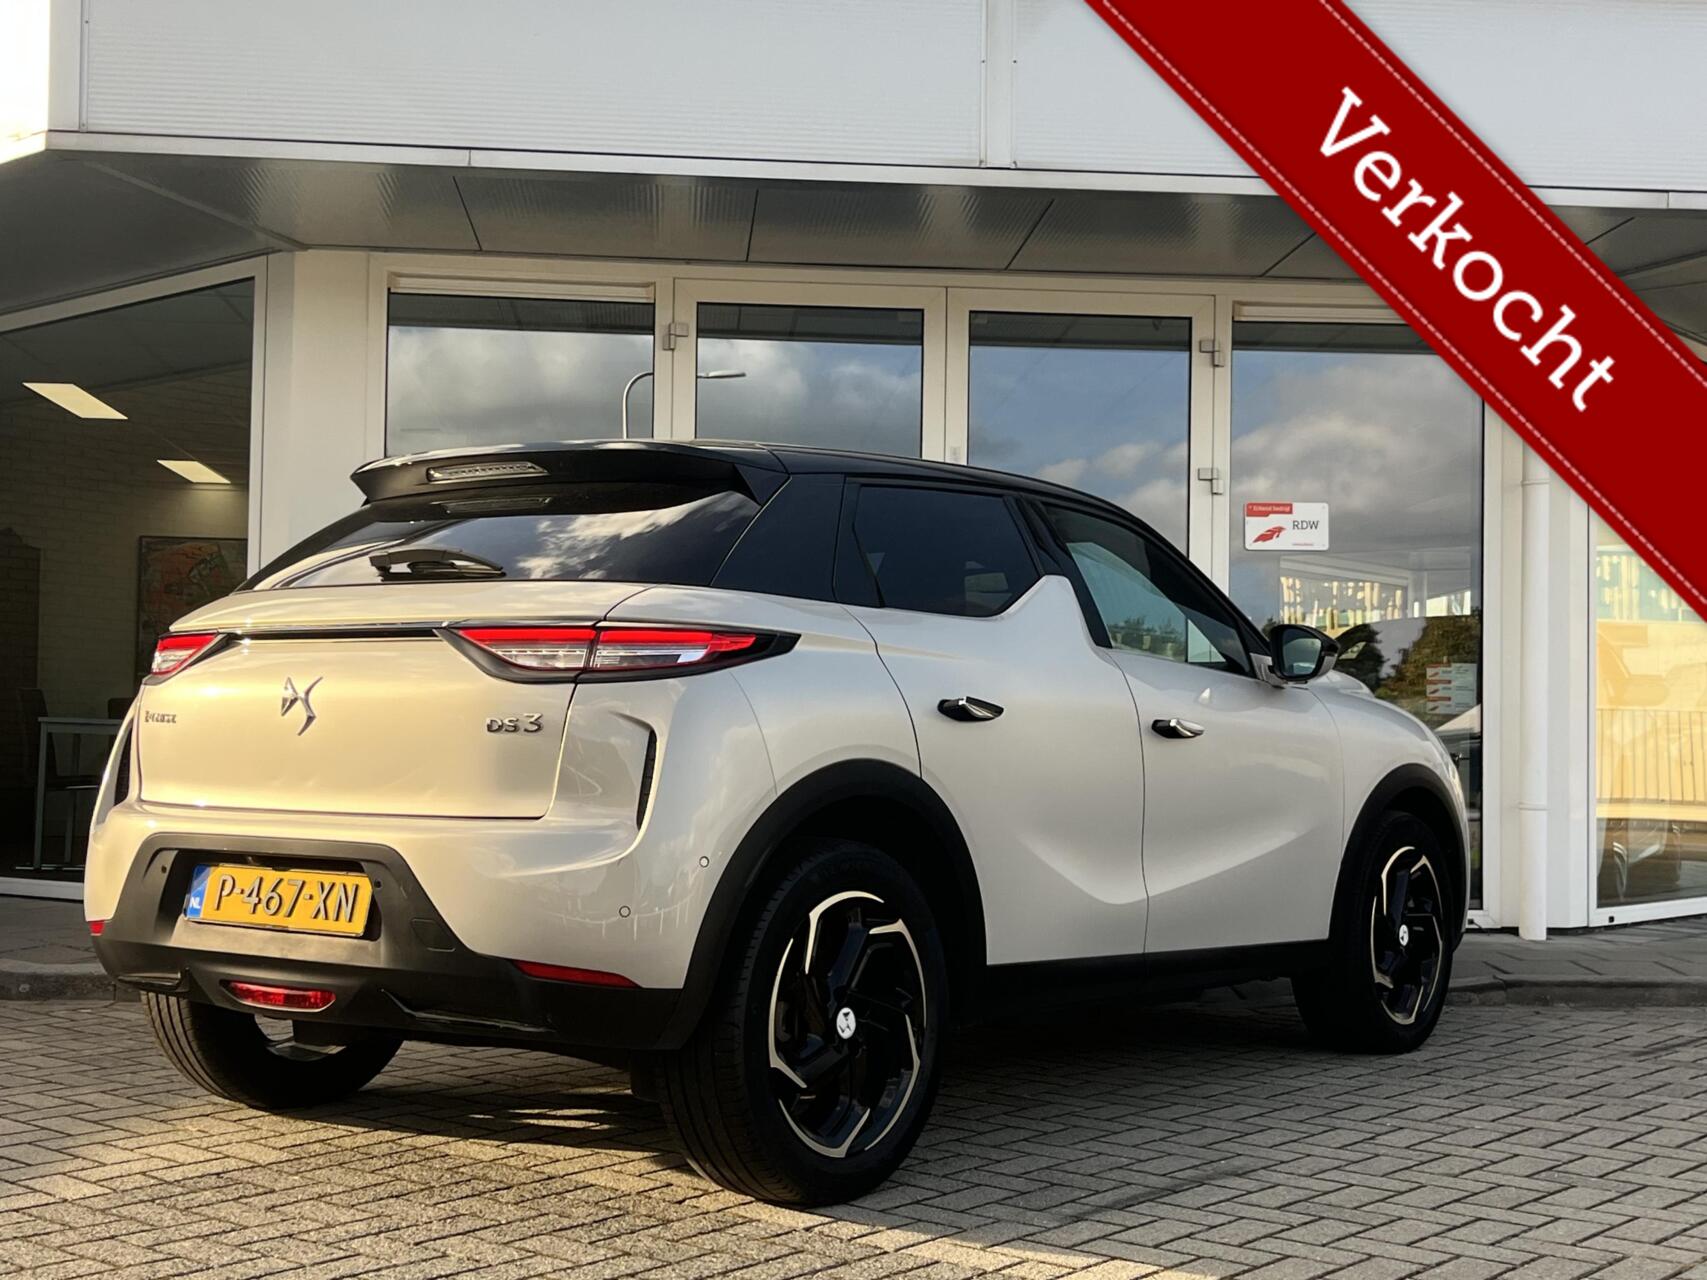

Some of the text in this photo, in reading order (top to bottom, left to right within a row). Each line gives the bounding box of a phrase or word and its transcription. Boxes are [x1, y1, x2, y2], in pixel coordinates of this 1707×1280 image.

[1292, 520, 1320, 530] RDW
[189, 896, 201, 909] NL
[214, 873, 359, 923] P-467-XN
